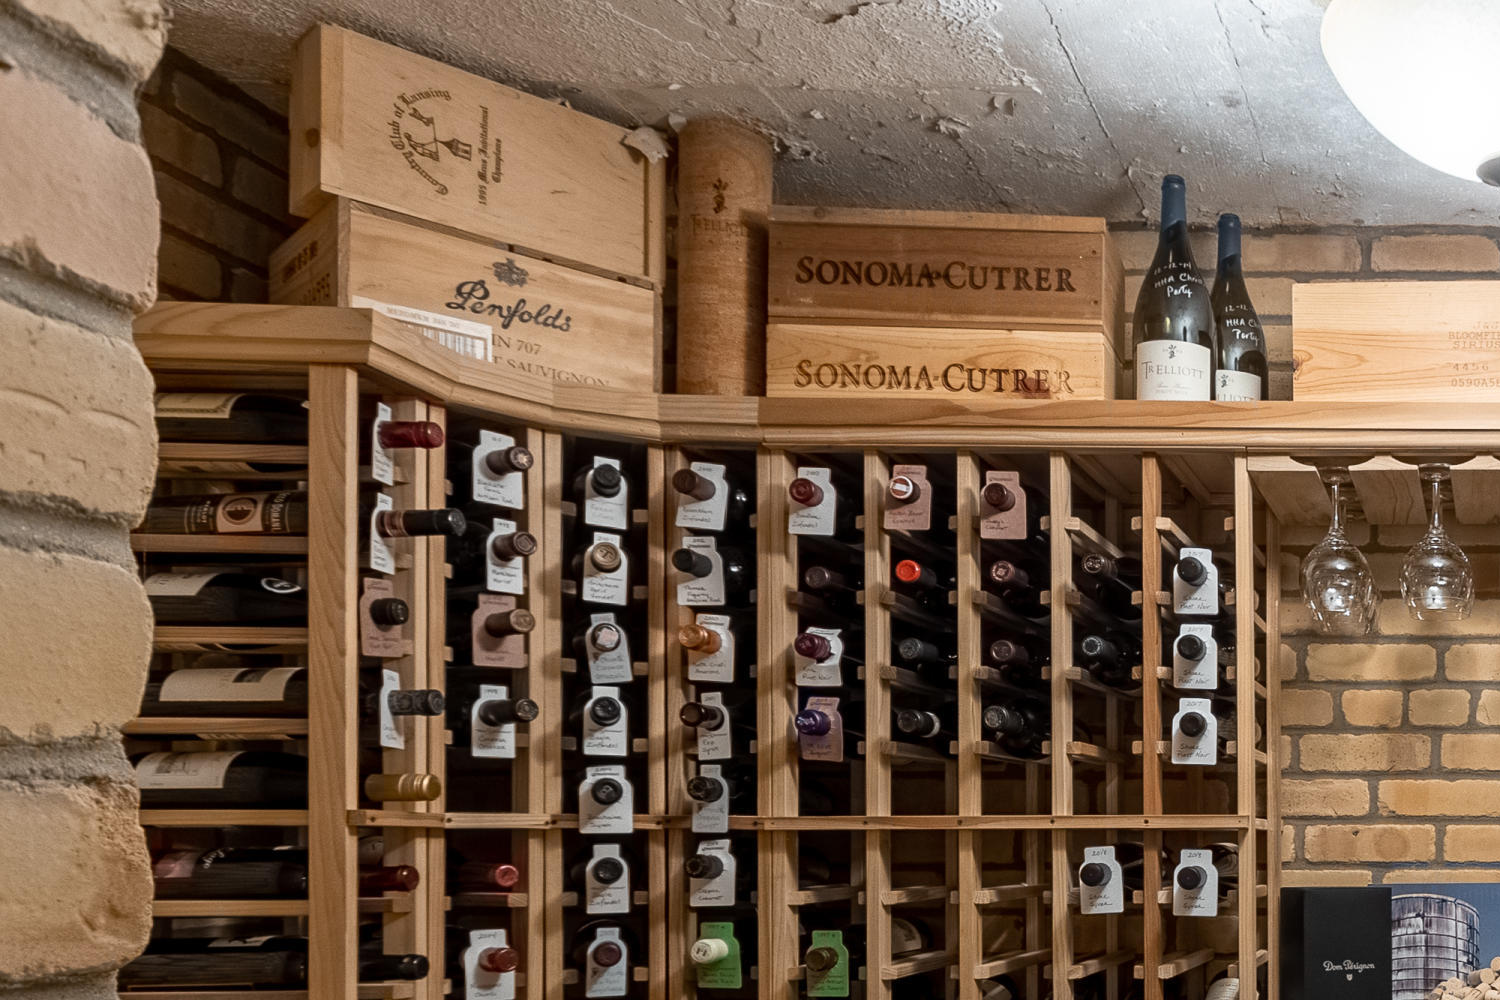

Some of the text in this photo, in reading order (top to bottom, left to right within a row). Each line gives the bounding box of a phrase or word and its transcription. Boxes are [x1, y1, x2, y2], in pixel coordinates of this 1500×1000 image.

[397, 87, 452, 106] Lansing
[394, 103, 406, 119] of
[387, 120, 406, 151] Club
[795, 256, 1077, 293] SONOMA-CUTRER
[445, 279, 572, 332] Penfolds
[490, 333, 543, 355] IN 707
[793, 359, 1075, 393] SONOMA-CUTRER
[1322, 960, 1343, 971] Dom
